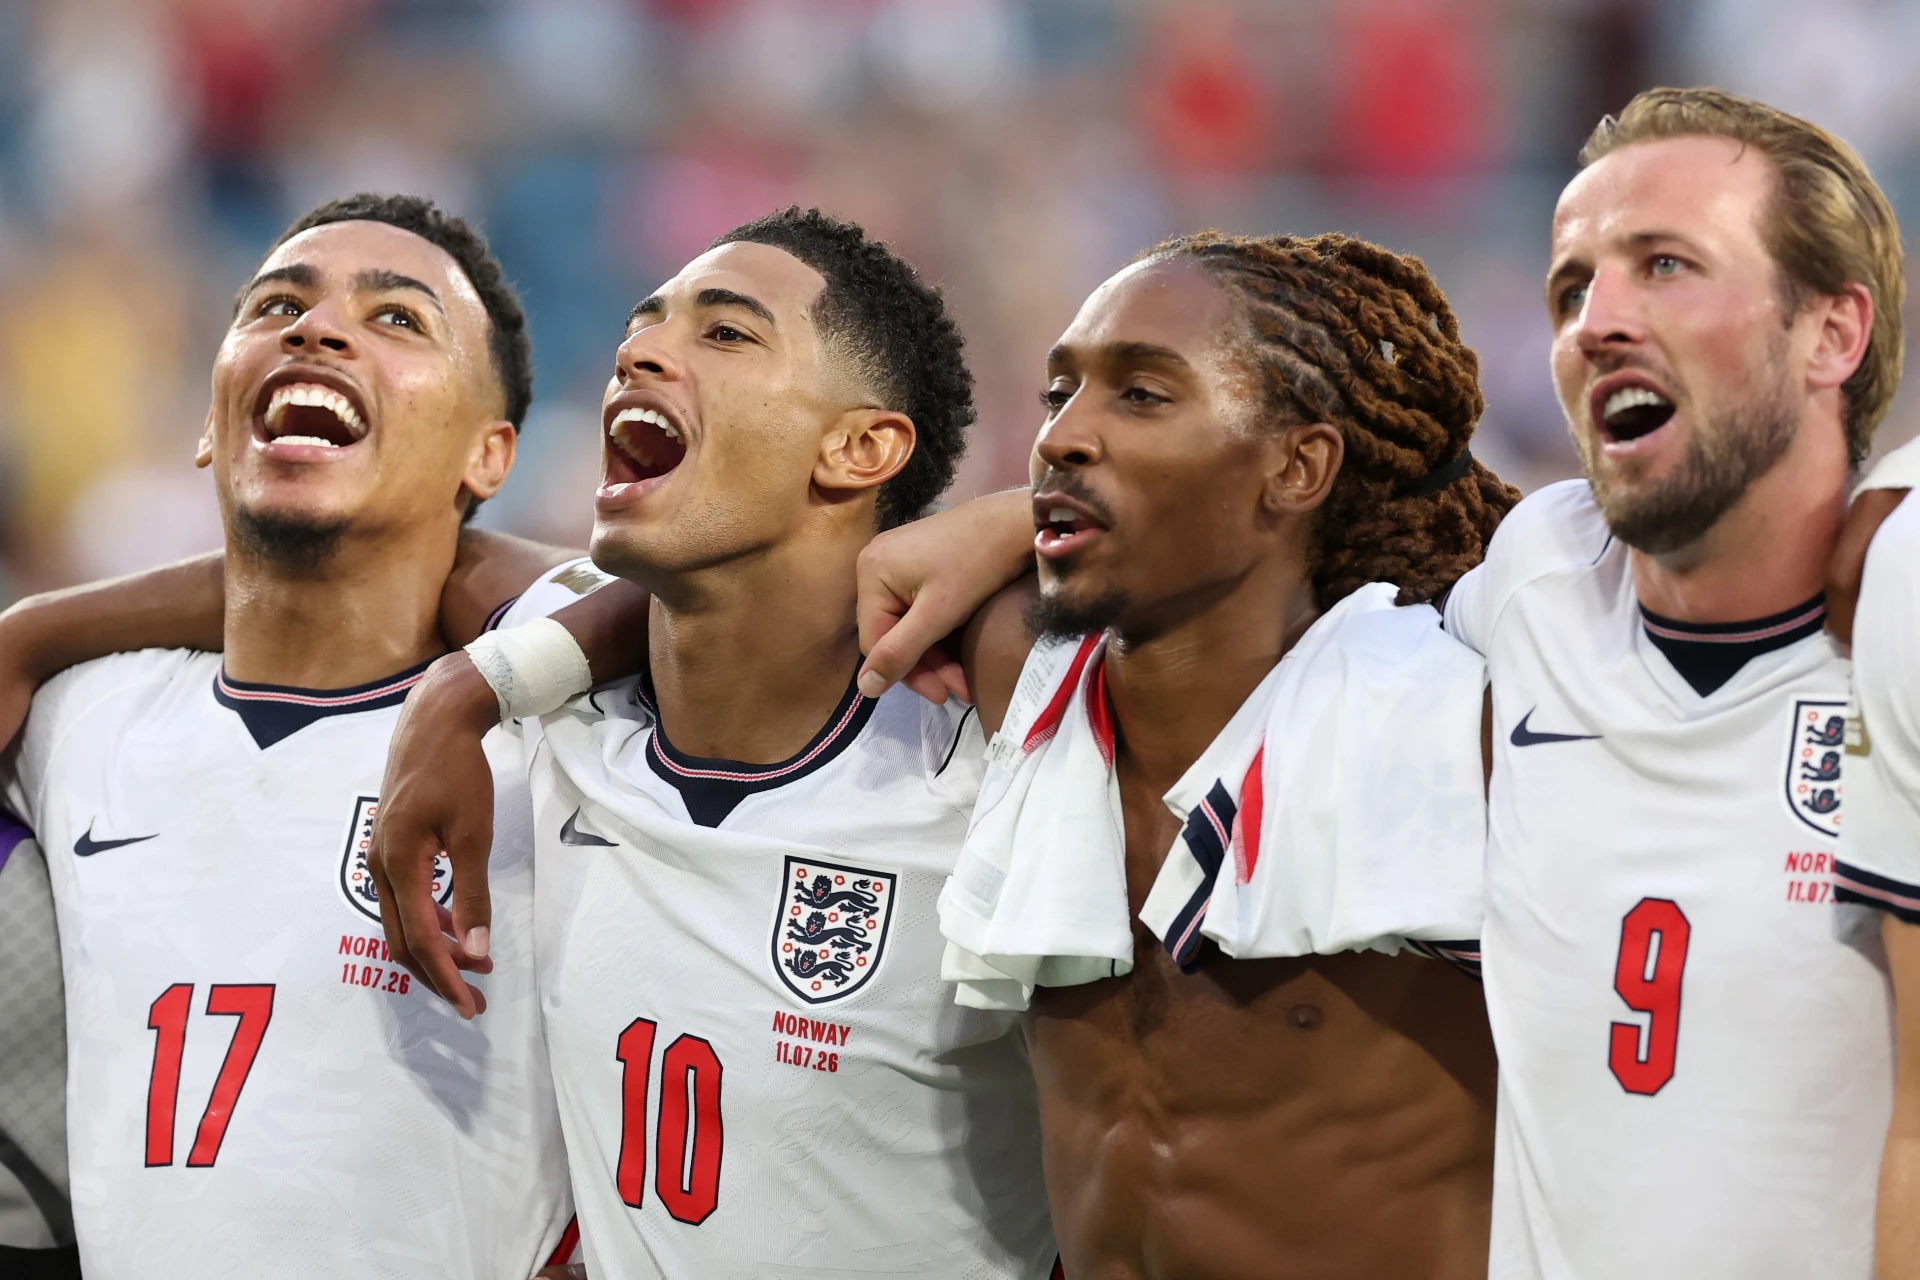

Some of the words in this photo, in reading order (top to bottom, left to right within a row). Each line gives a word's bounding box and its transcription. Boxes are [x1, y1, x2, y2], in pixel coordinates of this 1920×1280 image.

[1785, 852, 1836, 873] NOR
[342, 963, 411, 995] 11.07.26
[1608, 897, 1690, 1096] 9
[772, 1010, 851, 1046] NORWAY
[776, 1041, 838, 1073] 11.07.26
[145, 983, 276, 1168] 17
[616, 1017, 723, 1226] 10
